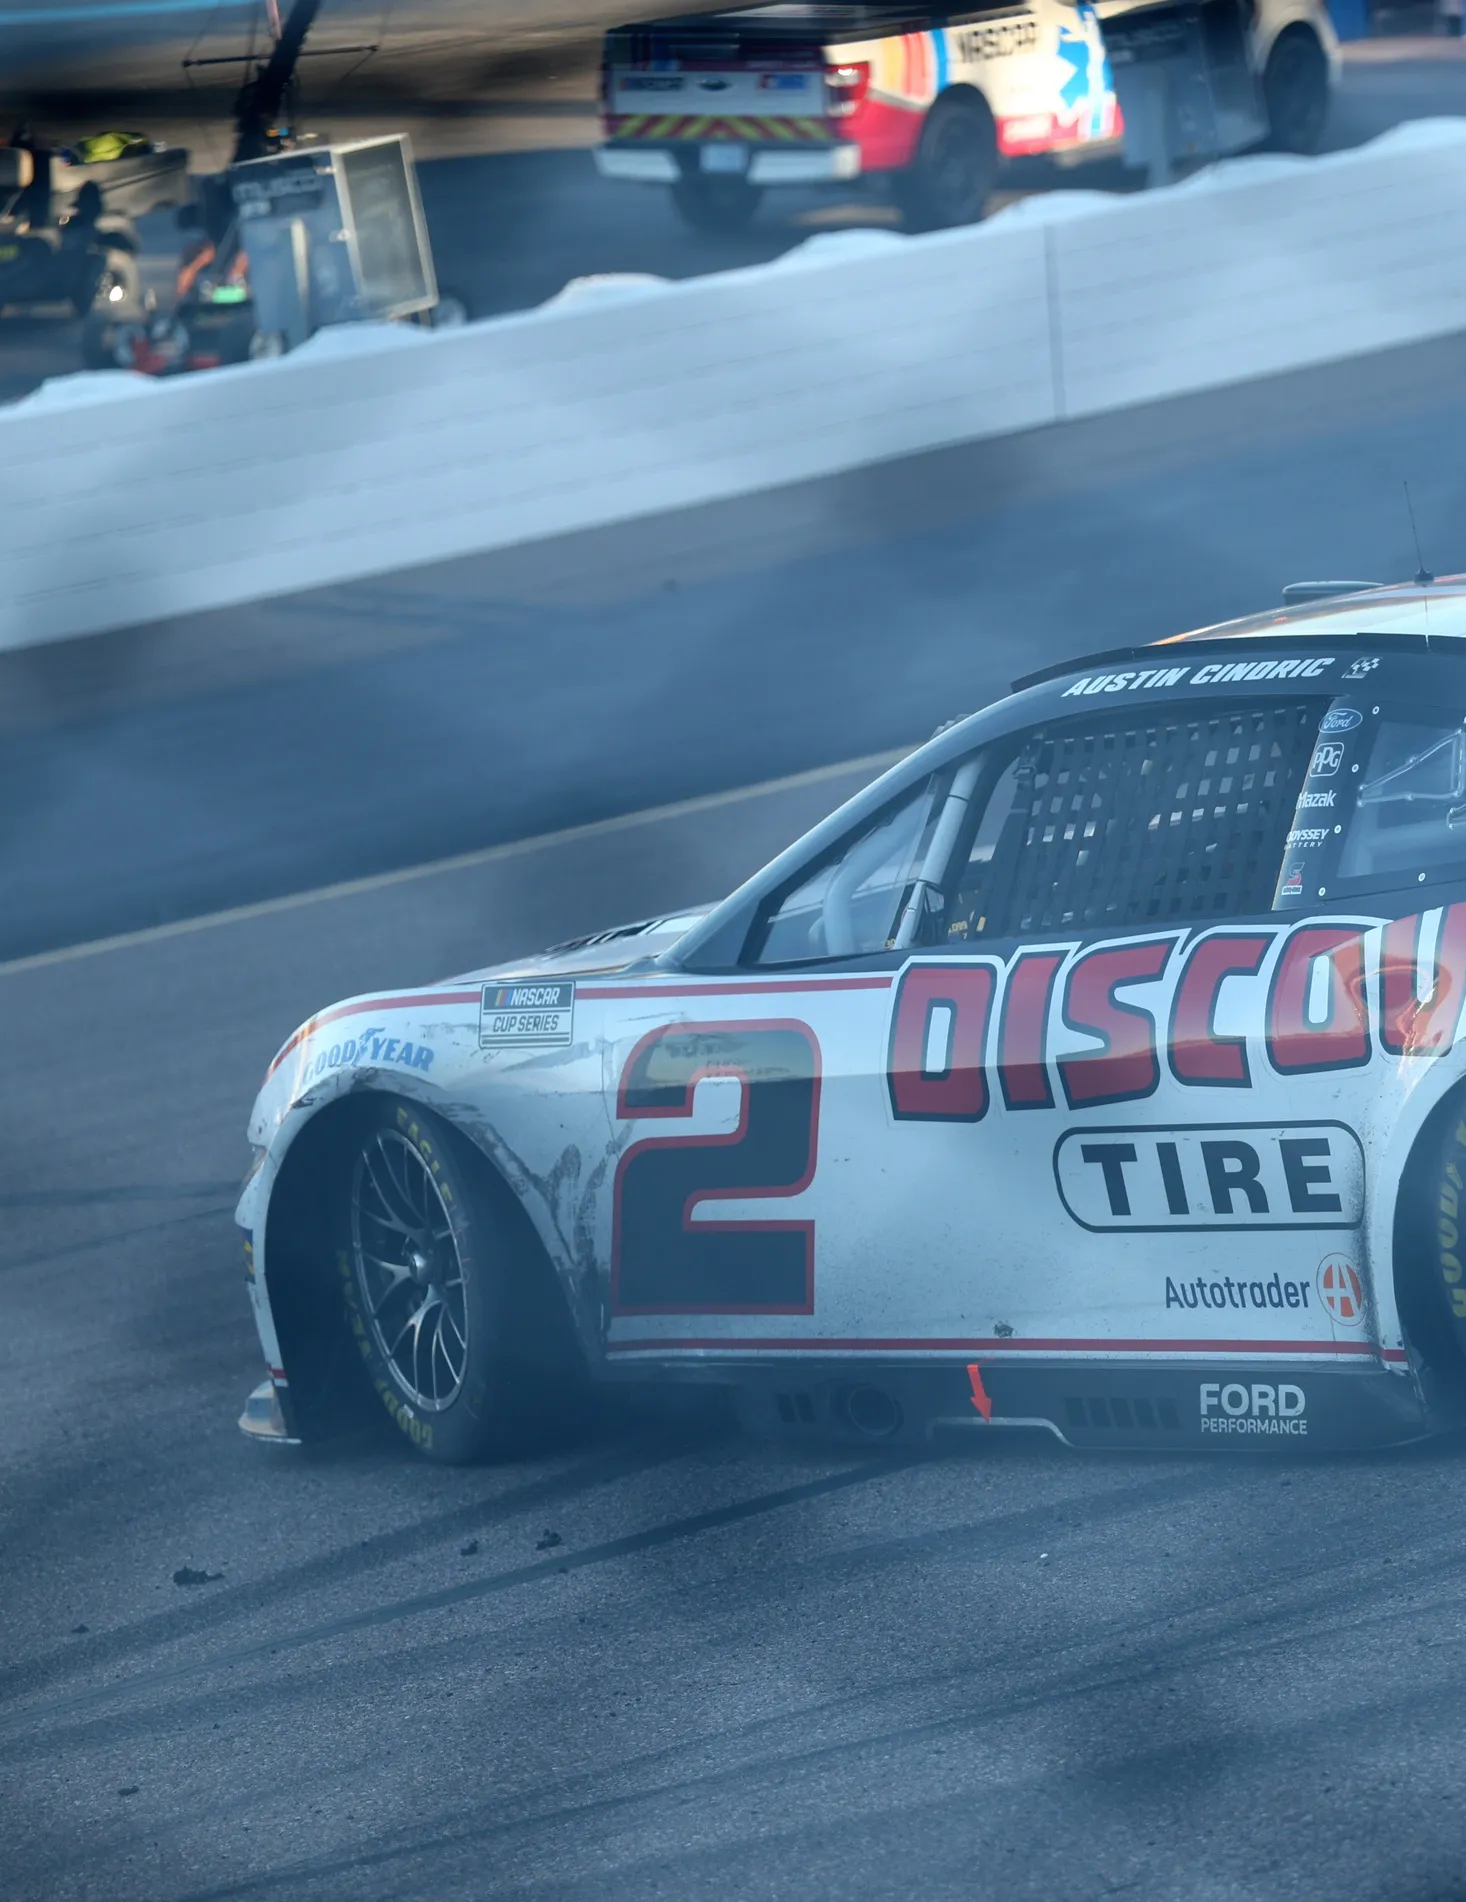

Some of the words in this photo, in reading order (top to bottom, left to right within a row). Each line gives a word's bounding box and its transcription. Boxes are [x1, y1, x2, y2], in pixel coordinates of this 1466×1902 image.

[1061, 666, 1190, 697] AUSTIN
[1190, 657, 1335, 684] CINDRIC
[1324, 712, 1353, 728] Ford
[510, 987, 561, 1006] NASCAR
[493, 1015, 517, 1032] CUP
[518, 1014, 560, 1032] SERIES
[610, 1017, 822, 1315] 2
[1080, 1138, 1342, 1216] TIRE
[1165, 1272, 1310, 1309] Autotrader
[1200, 1383, 1306, 1416] FORD
[1201, 1418, 1308, 1435] PERFORMANCE
